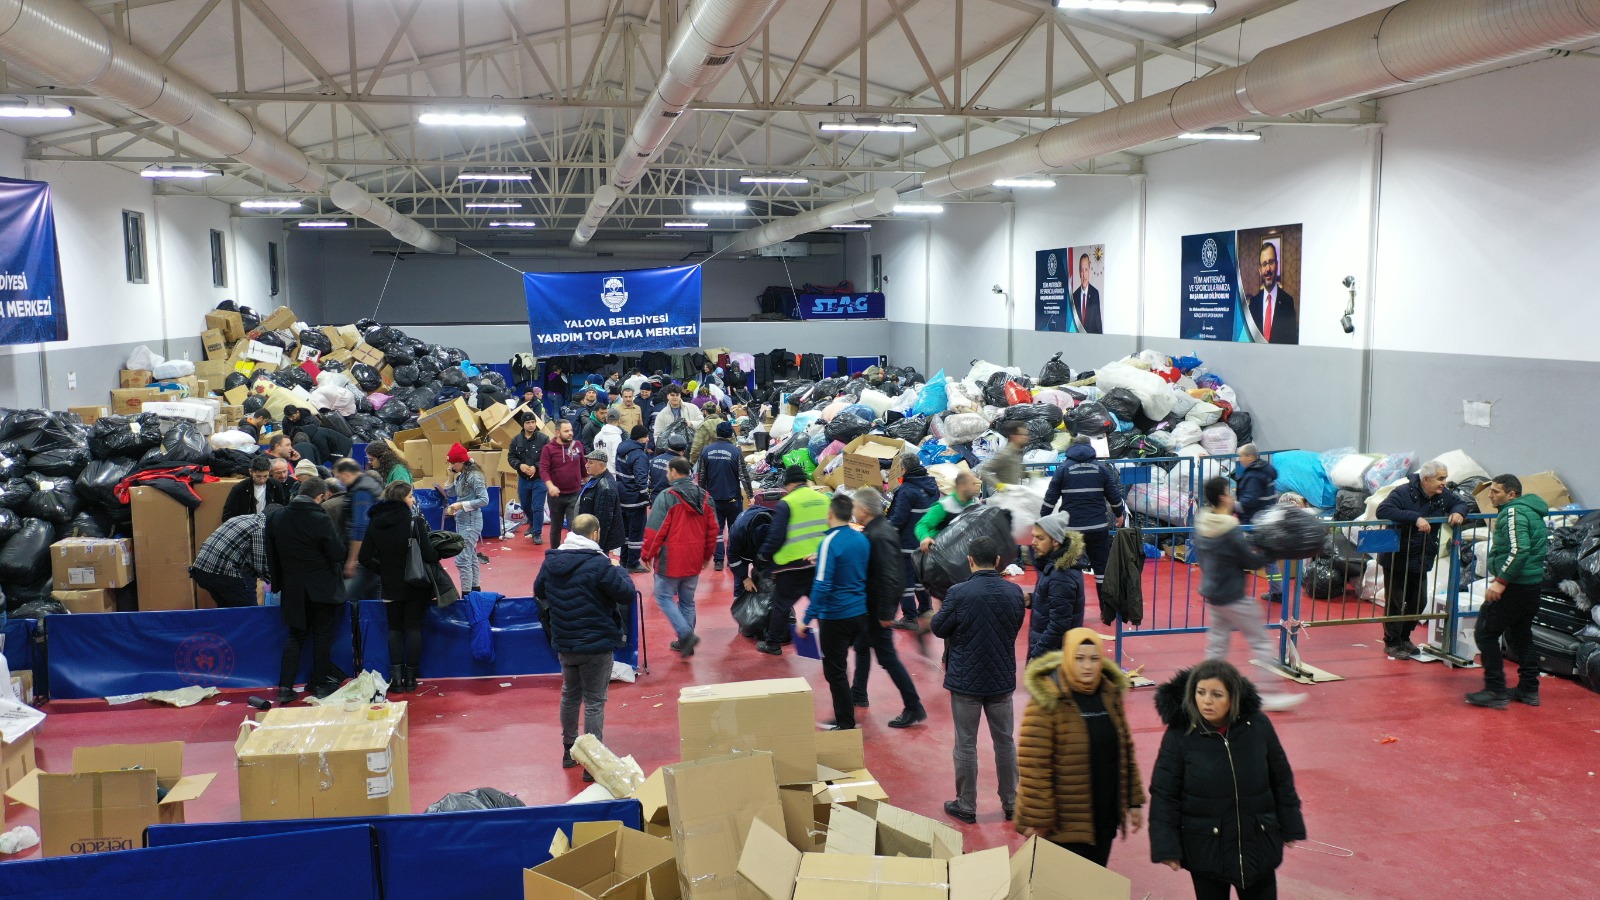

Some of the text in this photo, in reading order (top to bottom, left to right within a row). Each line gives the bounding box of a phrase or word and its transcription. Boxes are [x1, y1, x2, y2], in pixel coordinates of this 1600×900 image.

[7, 296, 52, 317] MERKEZİ
[812, 296, 868, 314] STAG
[564, 313, 669, 329] YALOVA BELEDİYESİ
[537, 323, 697, 344] YARDIM TOPLAMA MERKEZİ
